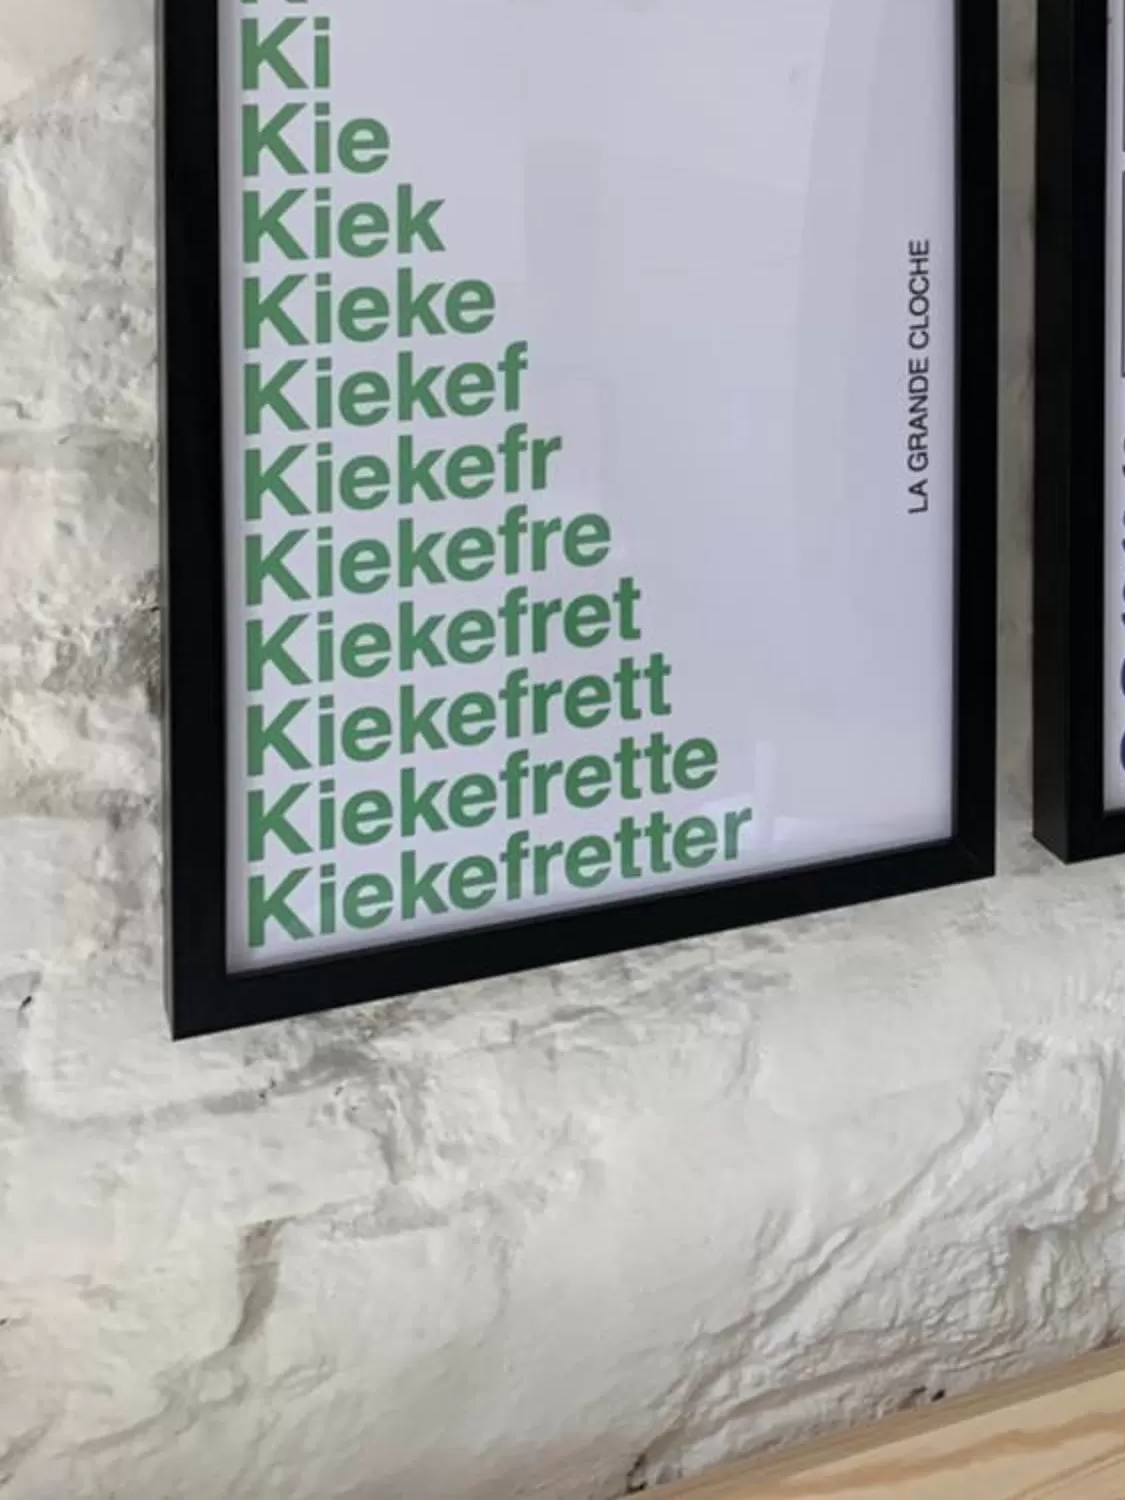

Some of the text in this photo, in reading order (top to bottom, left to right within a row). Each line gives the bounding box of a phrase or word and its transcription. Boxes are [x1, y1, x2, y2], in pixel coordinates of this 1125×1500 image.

[240, 17, 331, 90] Ki
[241, 103, 391, 177] Kie
[242, 184, 446, 263] Kiek
[242, 268, 496, 350] Kieke
[243, 341, 529, 435] Kiekef
[907, 239, 930, 514] LA GRANDE CLOCHE
[243, 423, 563, 521] Kiekefr
[244, 504, 612, 606] Kiekefre
[245, 577, 643, 691] Kiekefret
[246, 652, 672, 776] Kiekefrett
[247, 731, 719, 862] Kiekefrette
[247, 807, 753, 948] Kiekefretter
